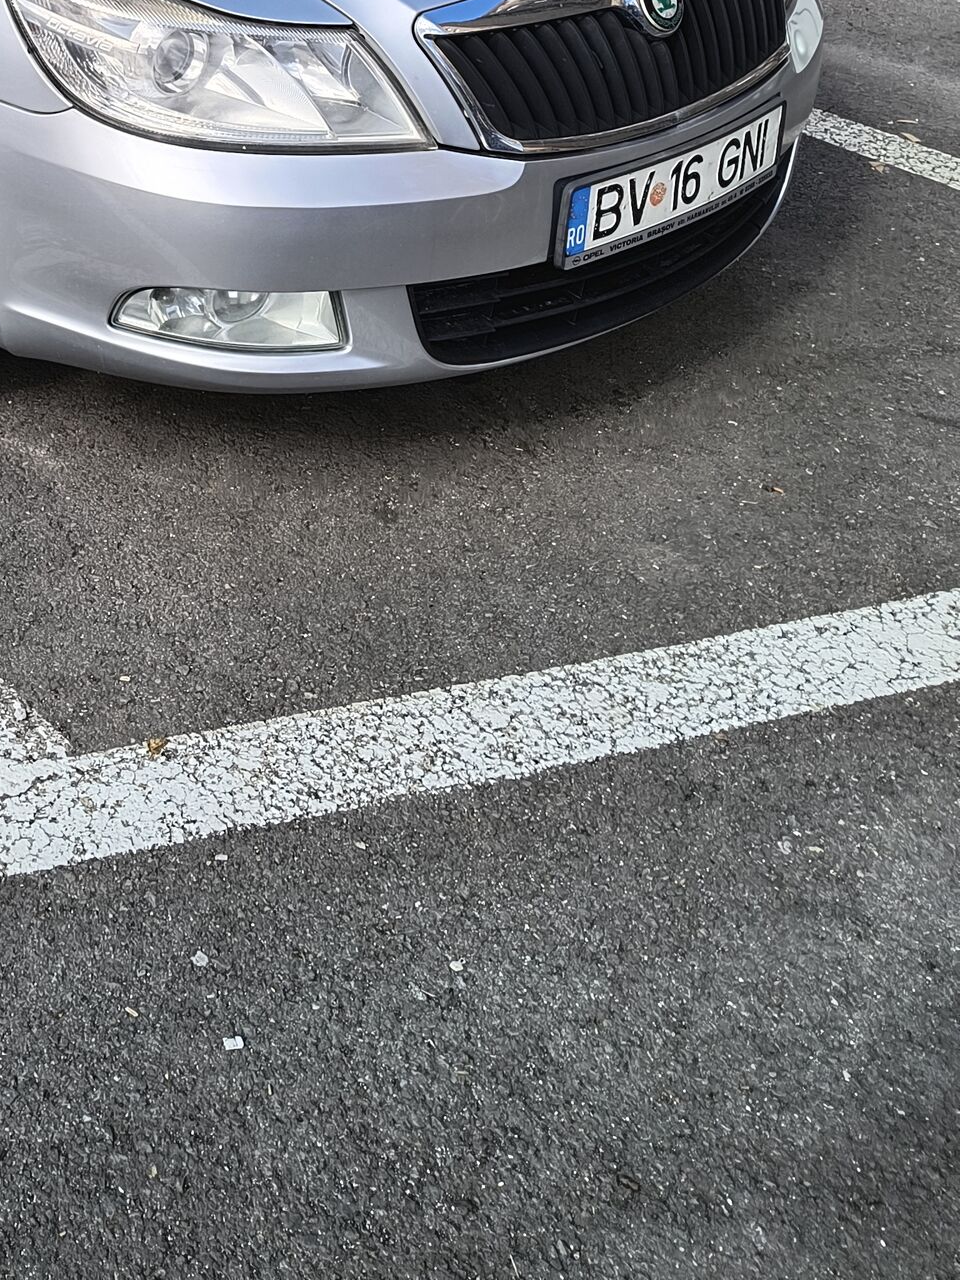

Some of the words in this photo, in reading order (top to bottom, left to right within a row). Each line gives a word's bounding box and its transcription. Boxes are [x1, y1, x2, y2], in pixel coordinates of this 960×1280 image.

[592, 171, 655, 240] BV
[670, 154, 703, 211] 16
[718, 119, 769, 188] GNI
[566, 224, 585, 248] RO
[583, 249, 604, 261] OPEL
[609, 234, 643, 252] VICTORIA
